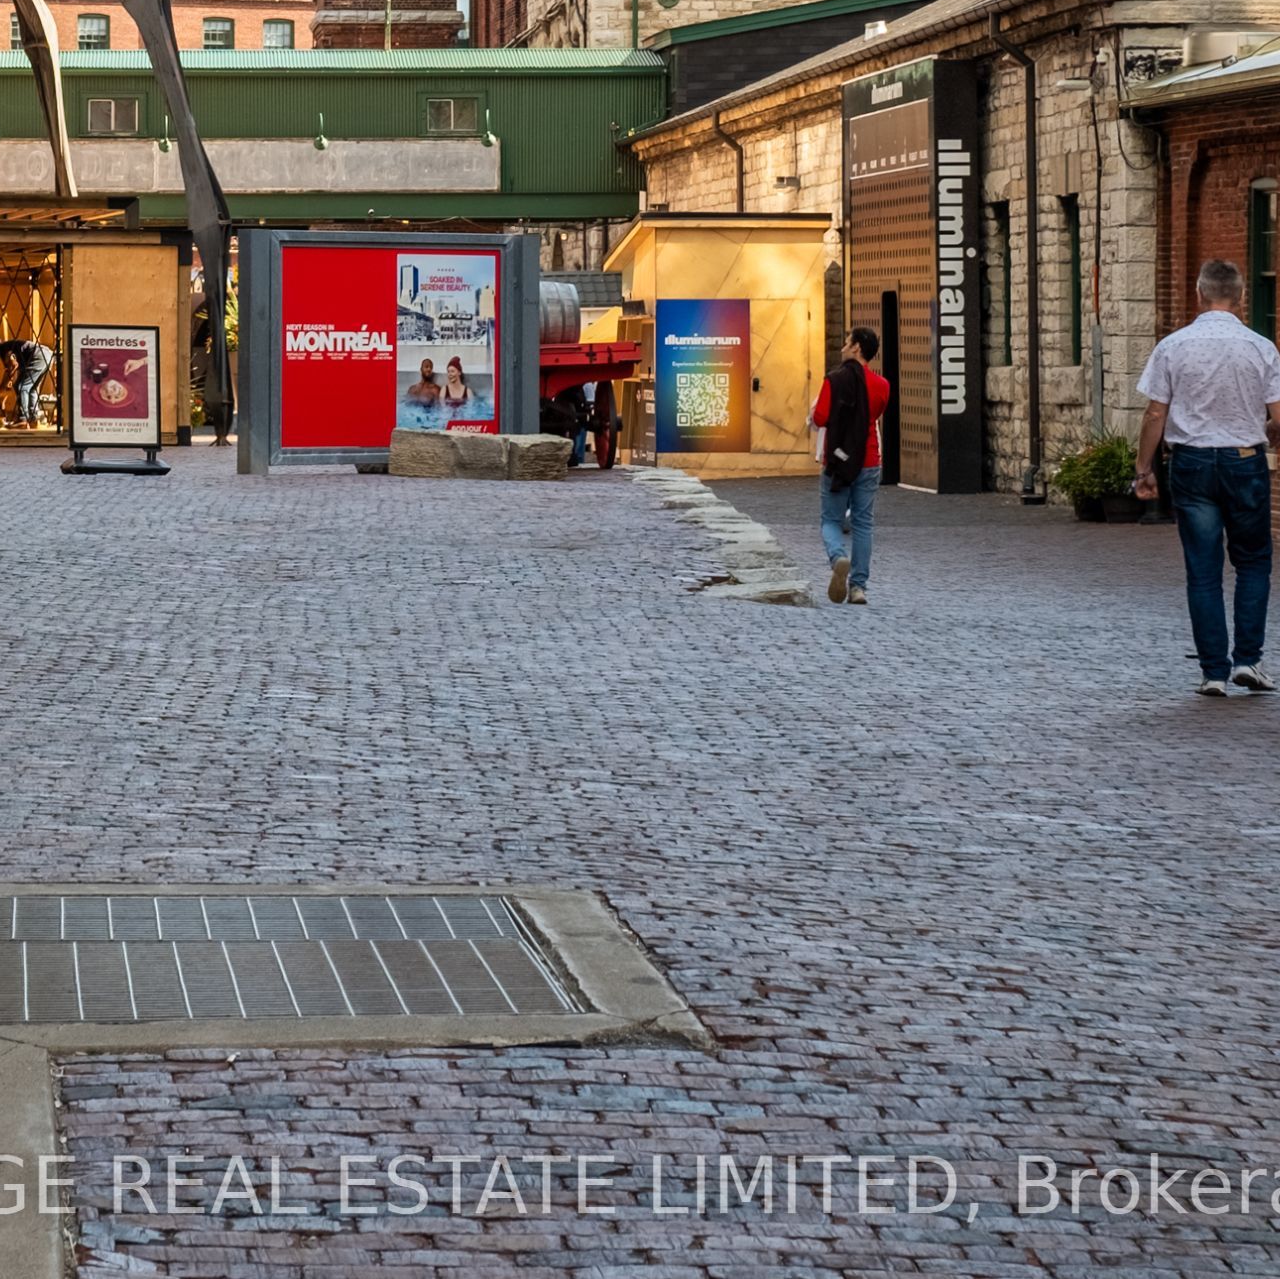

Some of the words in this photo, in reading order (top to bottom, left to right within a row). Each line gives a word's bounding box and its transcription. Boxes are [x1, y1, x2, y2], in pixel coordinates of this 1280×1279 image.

[938, 139, 976, 414] illuminarium
[81, 335, 138, 347] demetres
[286, 324, 393, 352] MONTRÉAL
